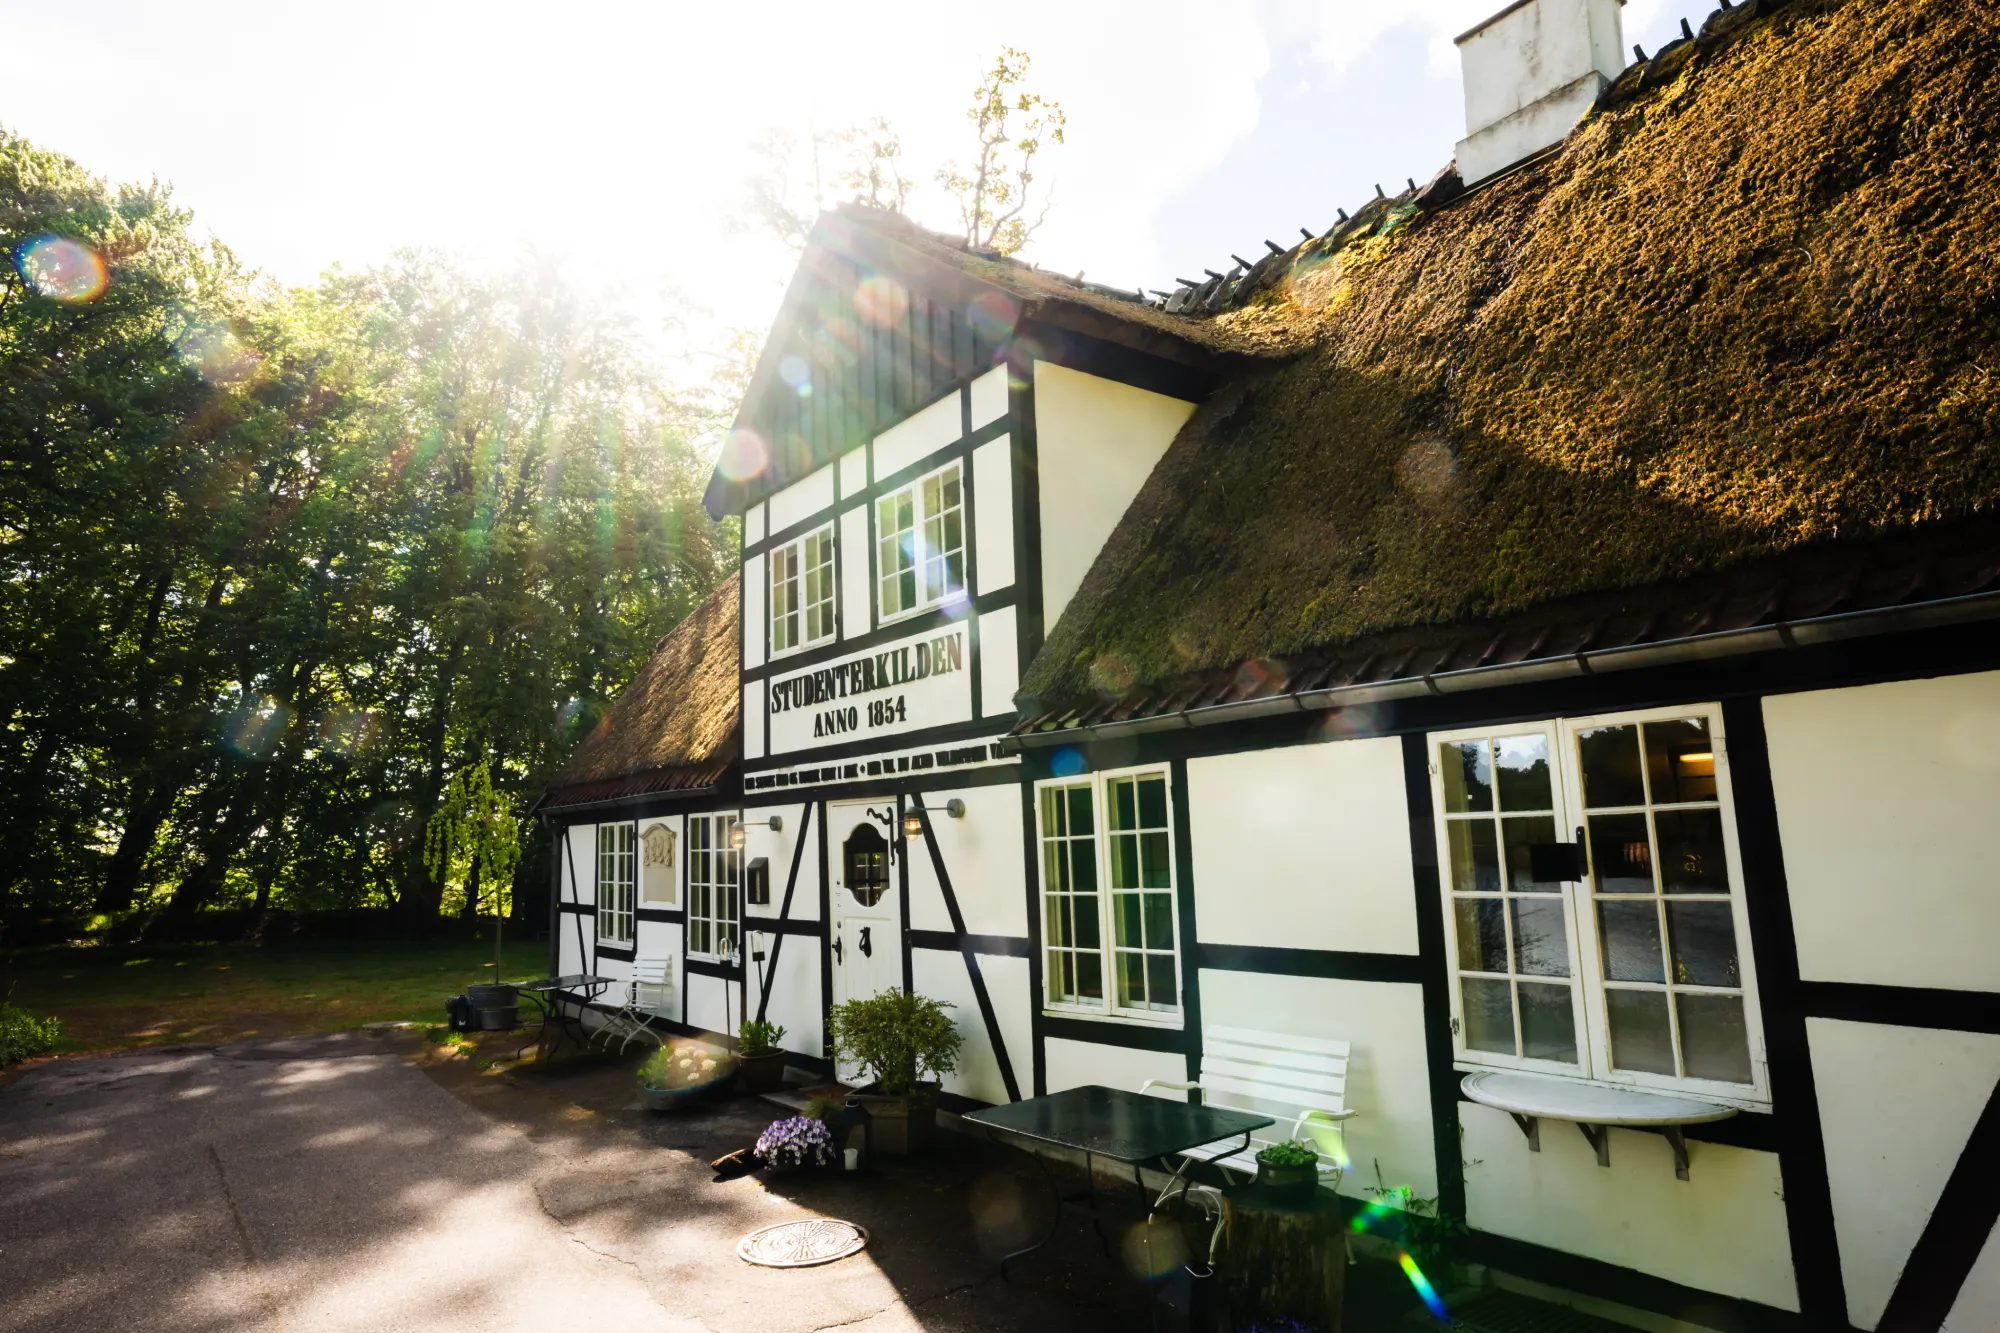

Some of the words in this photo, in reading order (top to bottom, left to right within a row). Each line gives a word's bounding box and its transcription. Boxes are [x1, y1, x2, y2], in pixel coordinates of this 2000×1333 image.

[771, 632, 962, 714] STUDENTERKILDEN
[813, 706, 858, 738] ANNO
[867, 694, 907, 728] 1854
